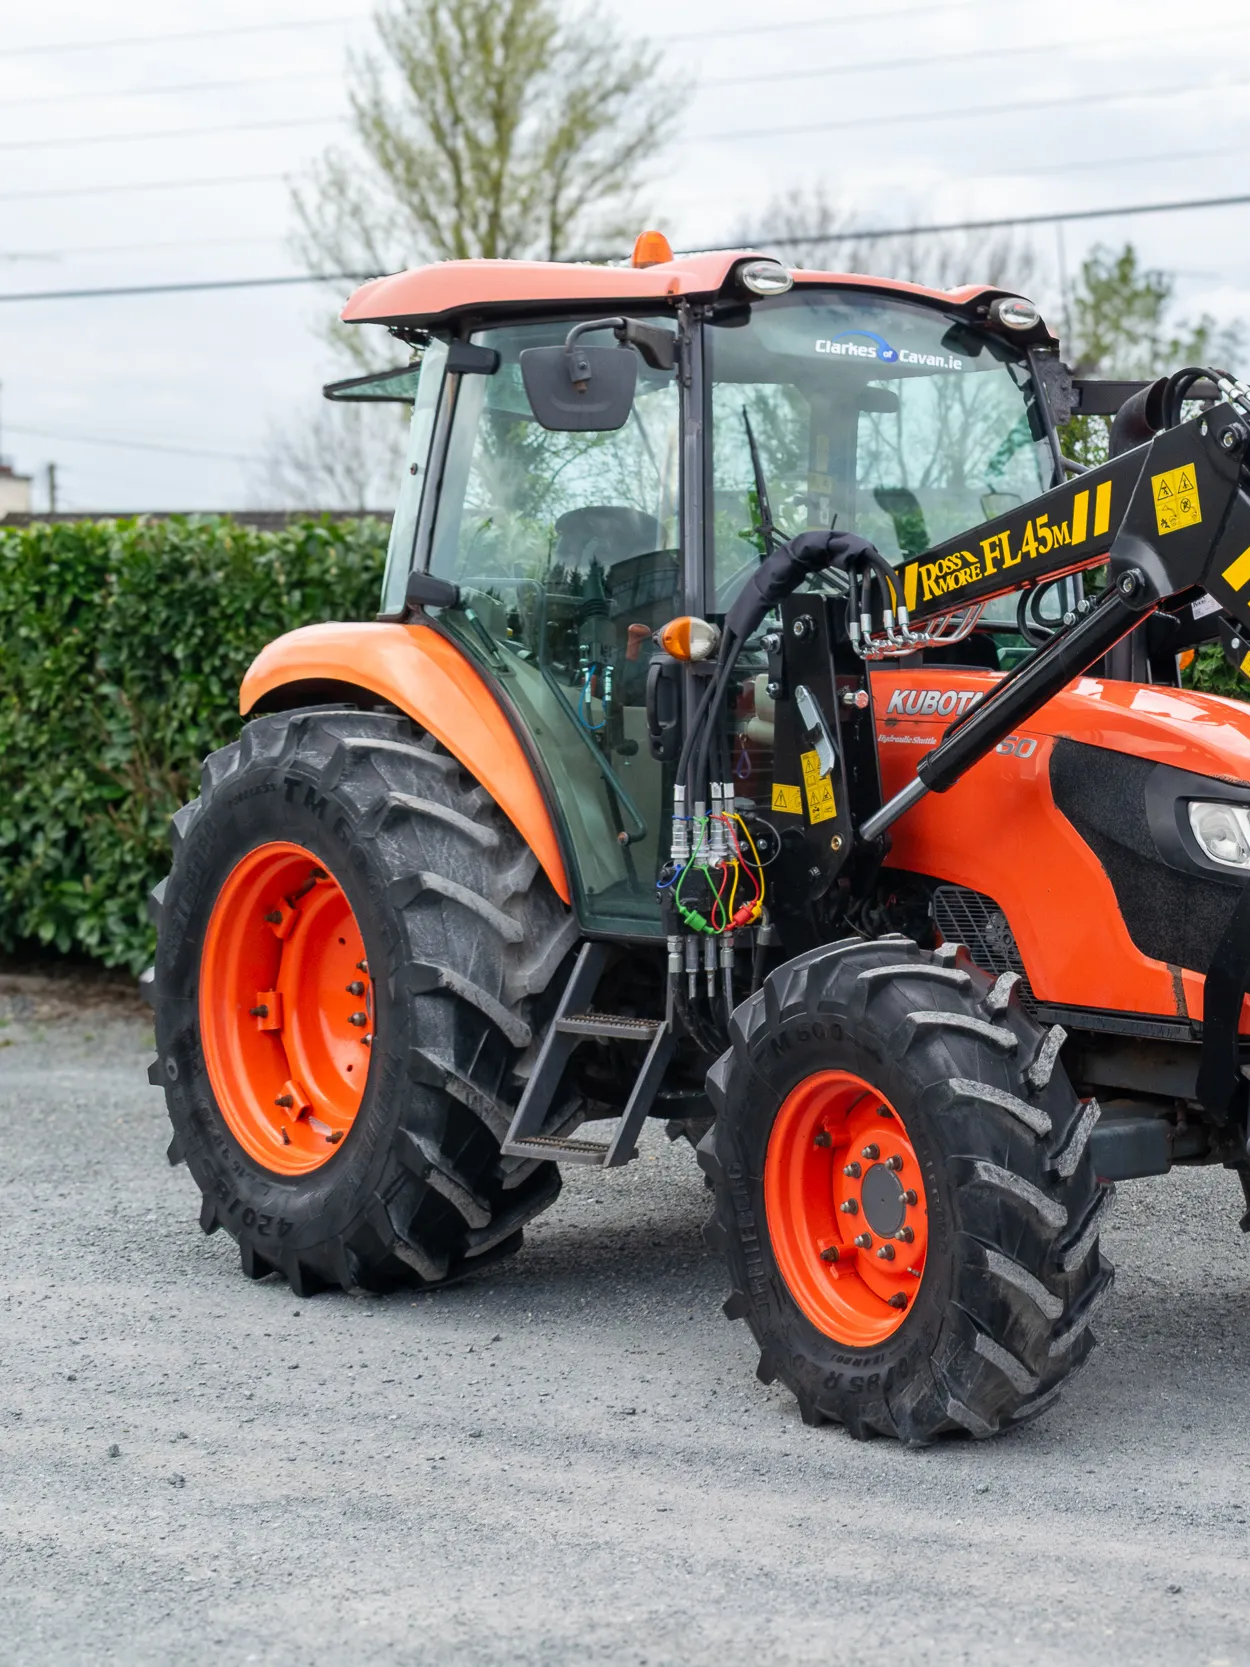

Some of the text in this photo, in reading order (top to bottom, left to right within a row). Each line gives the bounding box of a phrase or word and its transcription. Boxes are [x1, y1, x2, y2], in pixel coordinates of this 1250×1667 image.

[815, 340, 962, 370] Clarkes of Cavan.ie
[878, 734, 937, 745] Hydraulic Shuttle
